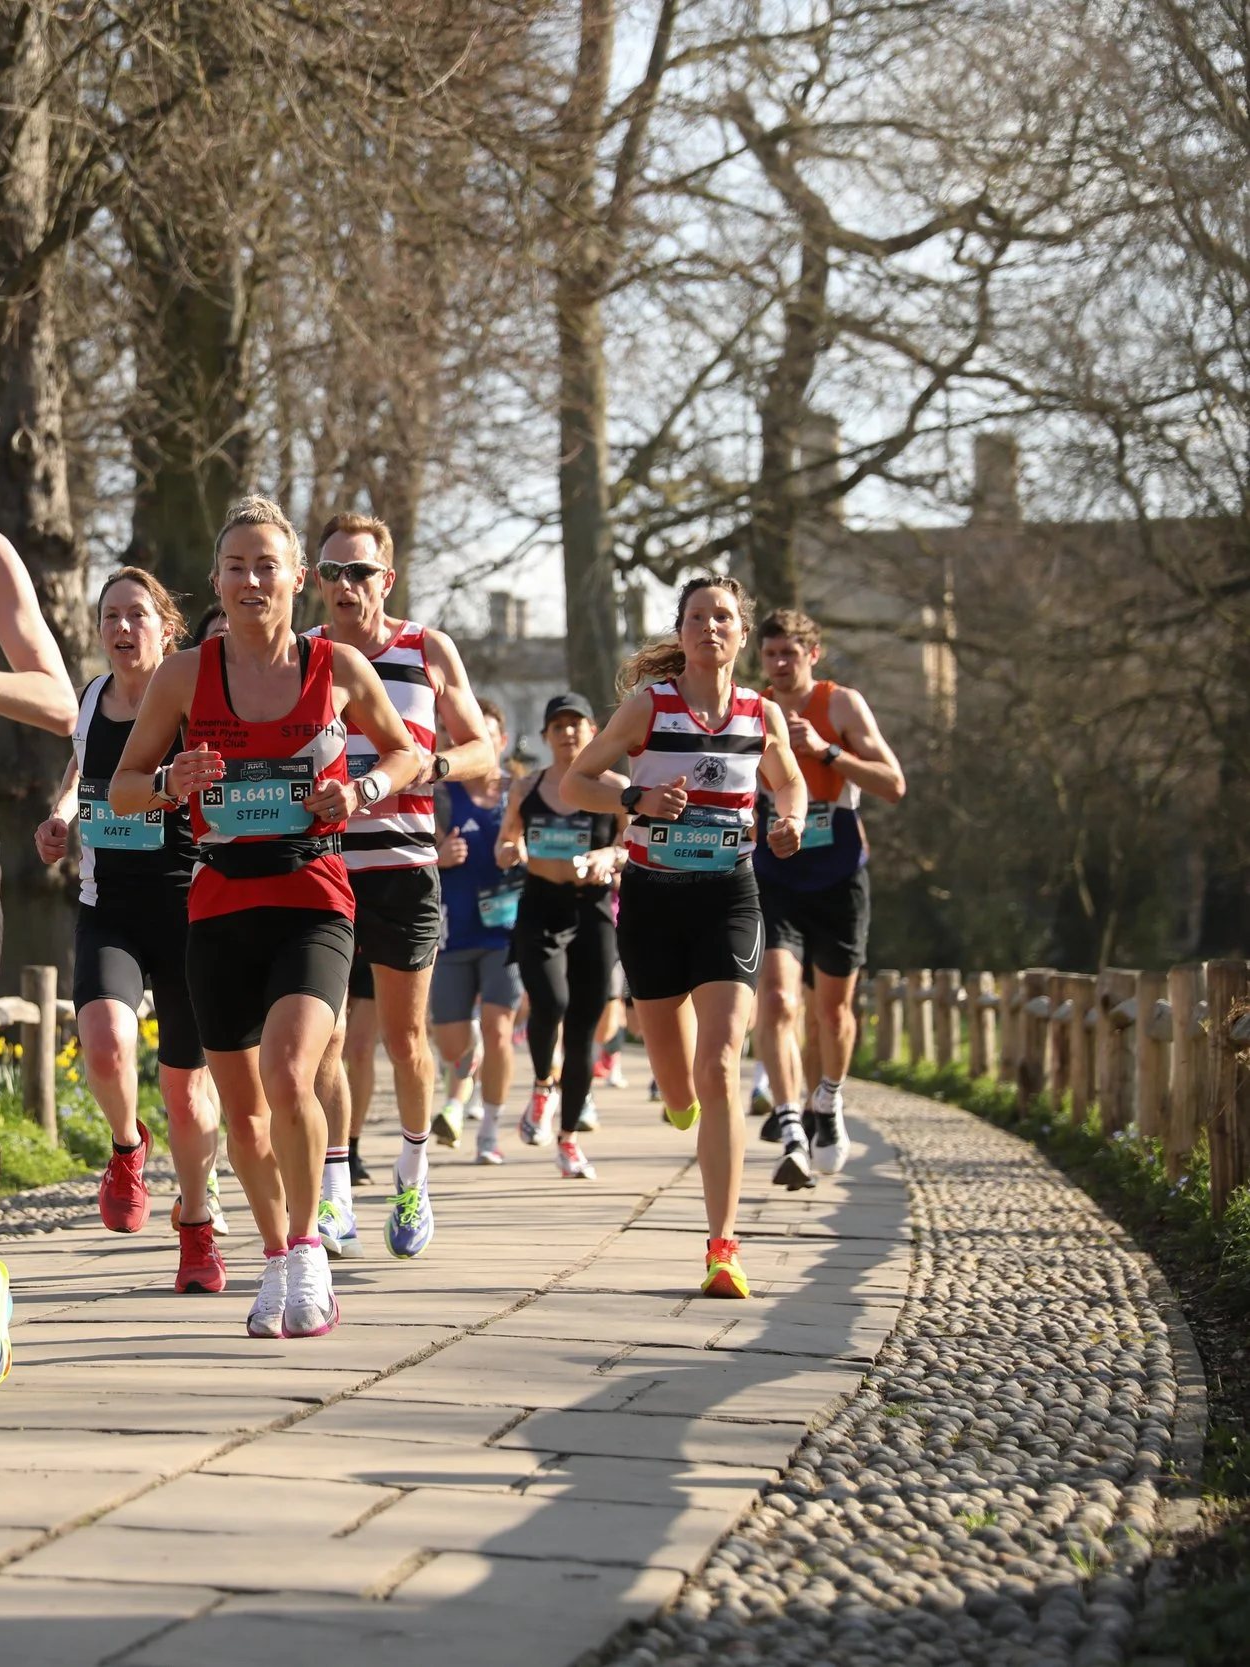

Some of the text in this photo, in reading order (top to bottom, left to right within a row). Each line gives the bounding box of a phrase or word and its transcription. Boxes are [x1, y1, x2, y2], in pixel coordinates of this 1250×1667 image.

[219, 729, 249, 739] Flyers
[281, 723, 334, 737] STEPH
[223, 738, 247, 748] Club
[230, 787, 285, 802] B.6419
[236, 808, 279, 820] STEPH
[103, 826, 132, 837] KATE
[674, 831, 718, 845] B.3690
